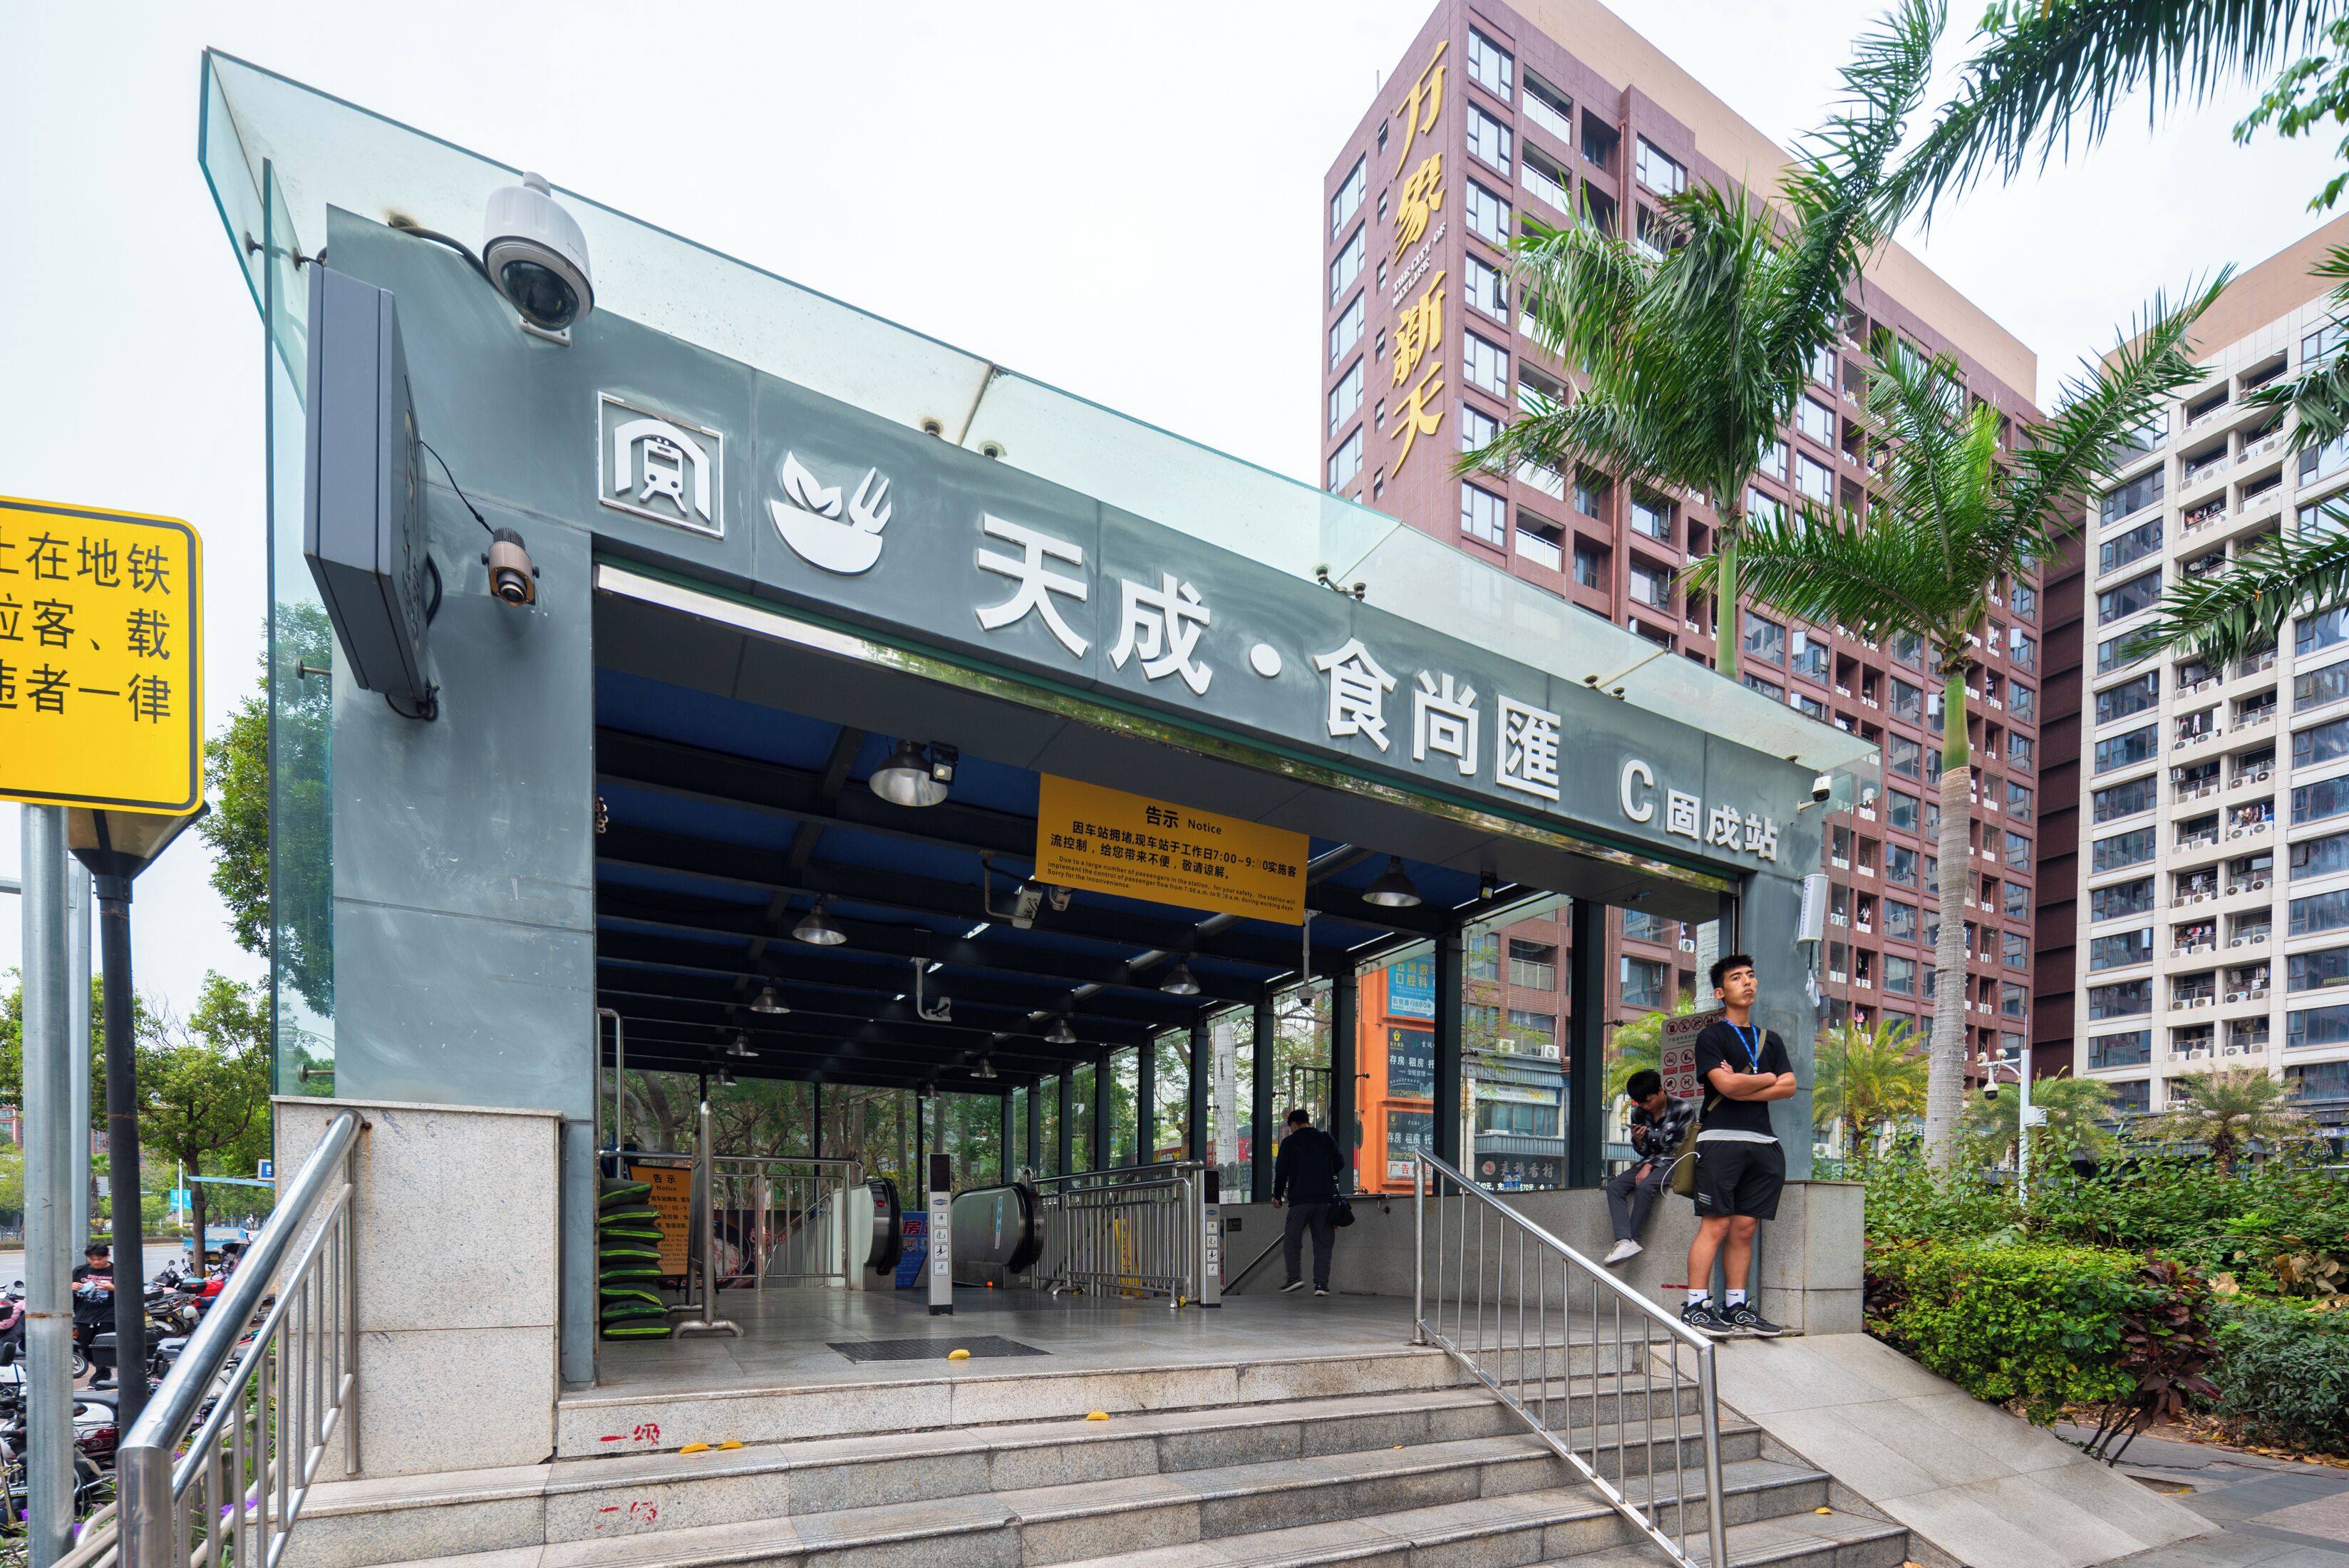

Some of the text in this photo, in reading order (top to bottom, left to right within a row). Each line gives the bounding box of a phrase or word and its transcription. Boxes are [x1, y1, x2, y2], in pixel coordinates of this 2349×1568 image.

[1411, 239, 1432, 271] CITY
[1145, 805, 1222, 835] 告示 Notice
[1621, 759, 1778, 862] C 固戍站
[1048, 869, 1064, 877] Sorry
[1085, 861, 1102, 870] large
[1103, 864, 1127, 873] number
[1135, 871, 1170, 882] passengers
[1124, 877, 1155, 887] passenger
[1241, 897, 1259, 905] during
[1259, 900, 1281, 909] working
[654, 1174, 676, 1184] 告示
[598, 1423, 660, 1446] 一级
